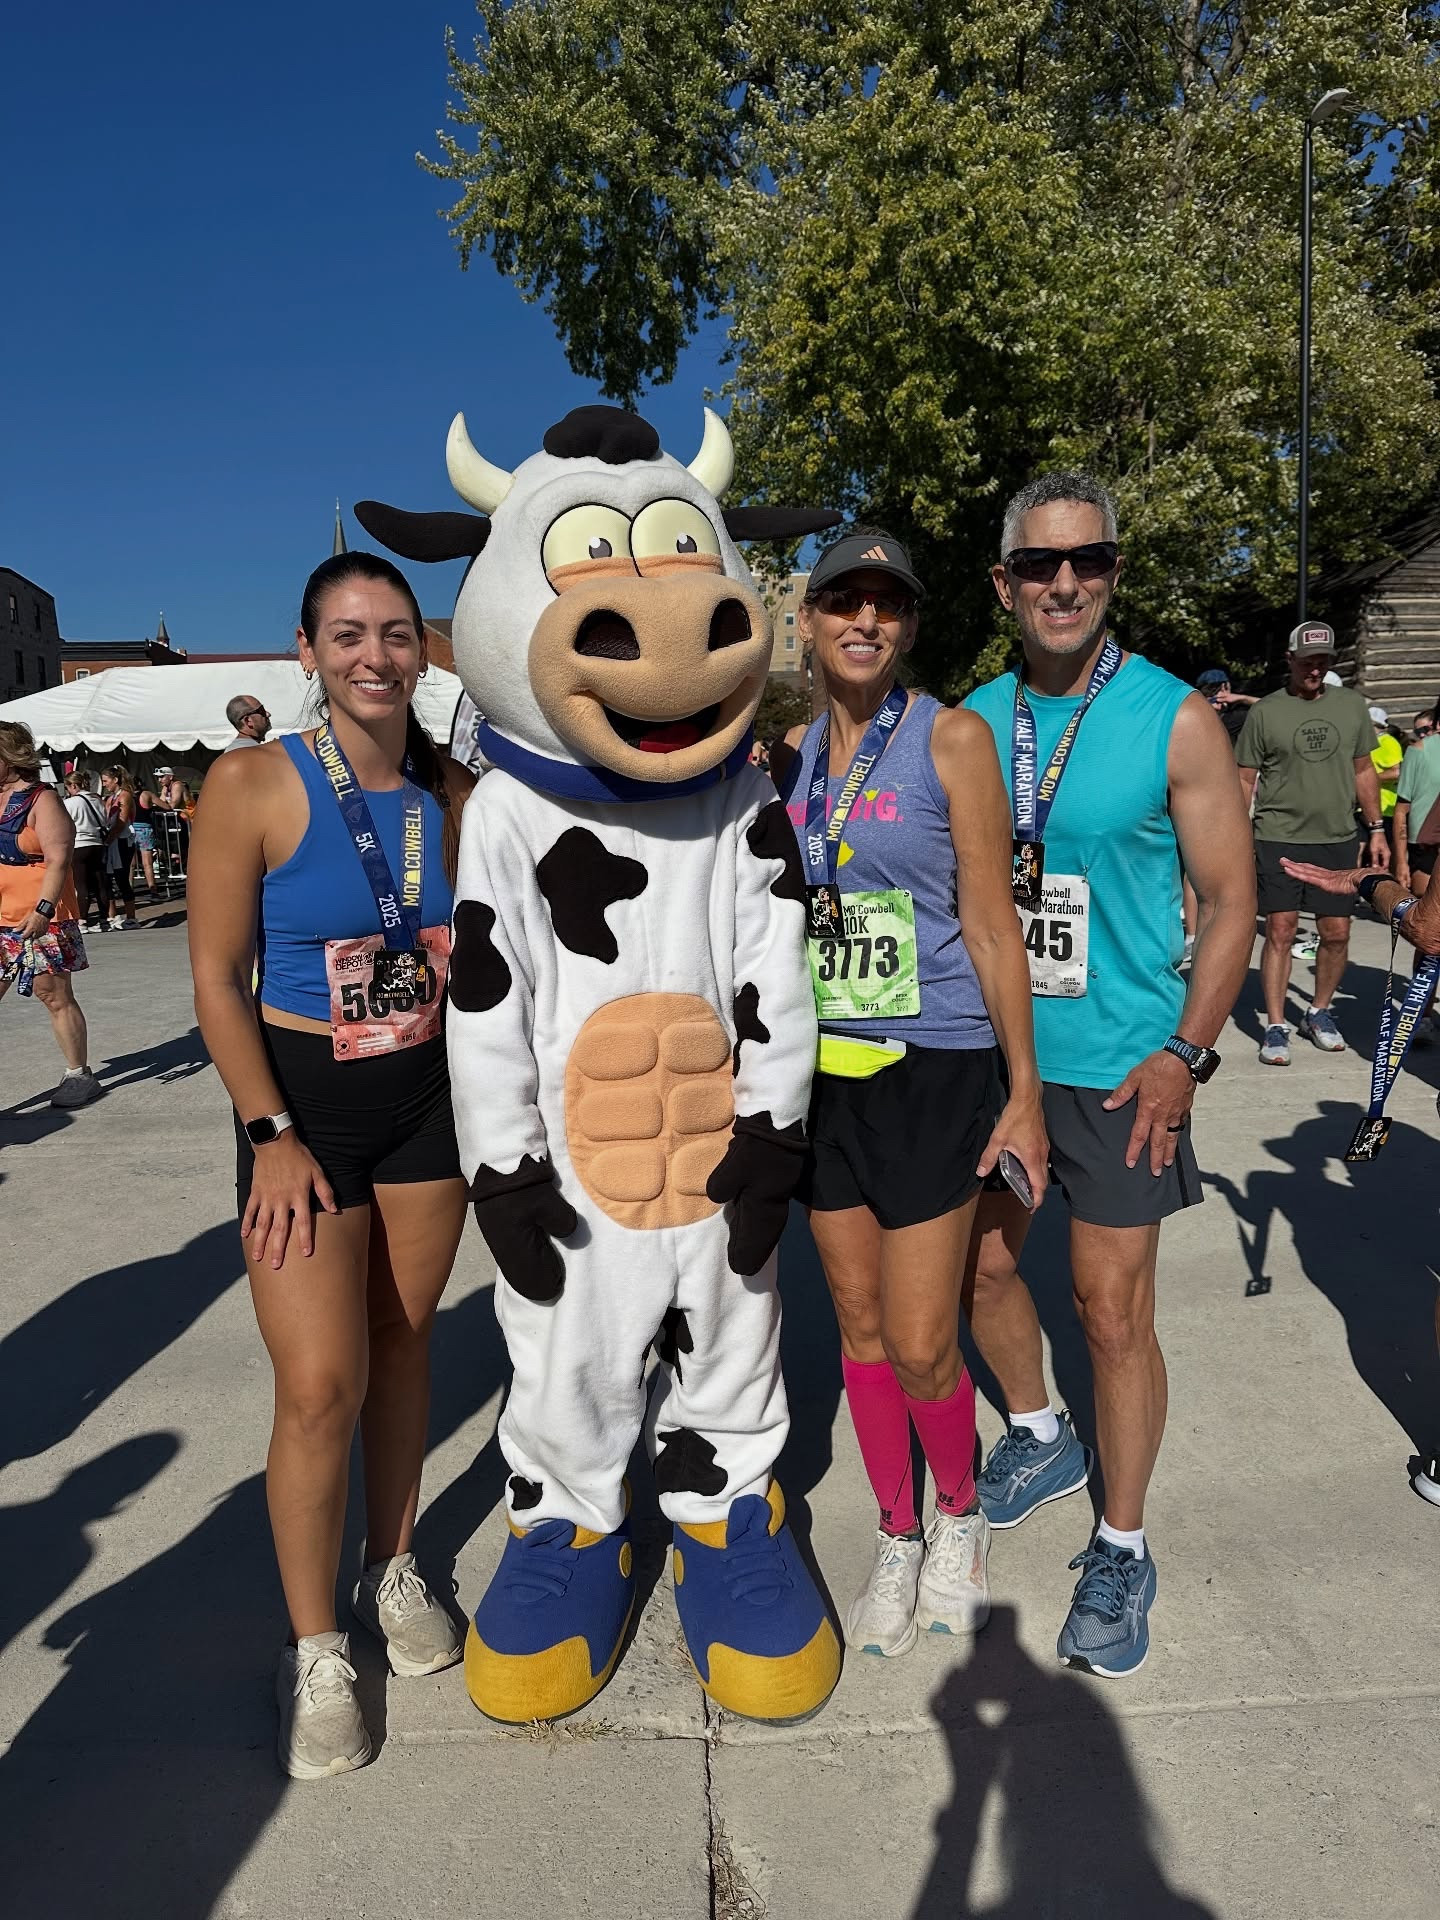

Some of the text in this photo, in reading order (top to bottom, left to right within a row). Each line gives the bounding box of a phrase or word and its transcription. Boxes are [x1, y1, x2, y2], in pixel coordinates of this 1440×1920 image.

[1016, 717, 1032, 751] HALF
[1302, 727, 1328, 735] SALTY
[1307, 734, 1326, 742] AND
[1309, 741, 1322, 749] LIT
[837, 754, 876, 807] COWBELL
[876, 705, 899, 729] 10K
[810, 776, 825, 800] 10K
[1015, 753, 1033, 826] MARATHON
[316, 735, 402, 928] COWBELL 5K 2025
[404, 806, 422, 869] COWBELL
[807, 833, 824, 866] 2025
[1040, 898, 1083, 915] Marathon
[1041, 887, 1071, 899] owbell
[844, 915, 869, 935] 10K
[1020, 917, 1073, 961] 45
[335, 960, 362, 971] DEPOT
[818, 936, 900, 981] 3773
[1031, 980, 1048, 990] 1845
[861, 1003, 880, 1012] 3773
[1389, 973, 1432, 1056] COWBELL HALF
[1380, 1008, 1391, 1038] HALF
[1372, 1040, 1389, 1102] MARATHON
